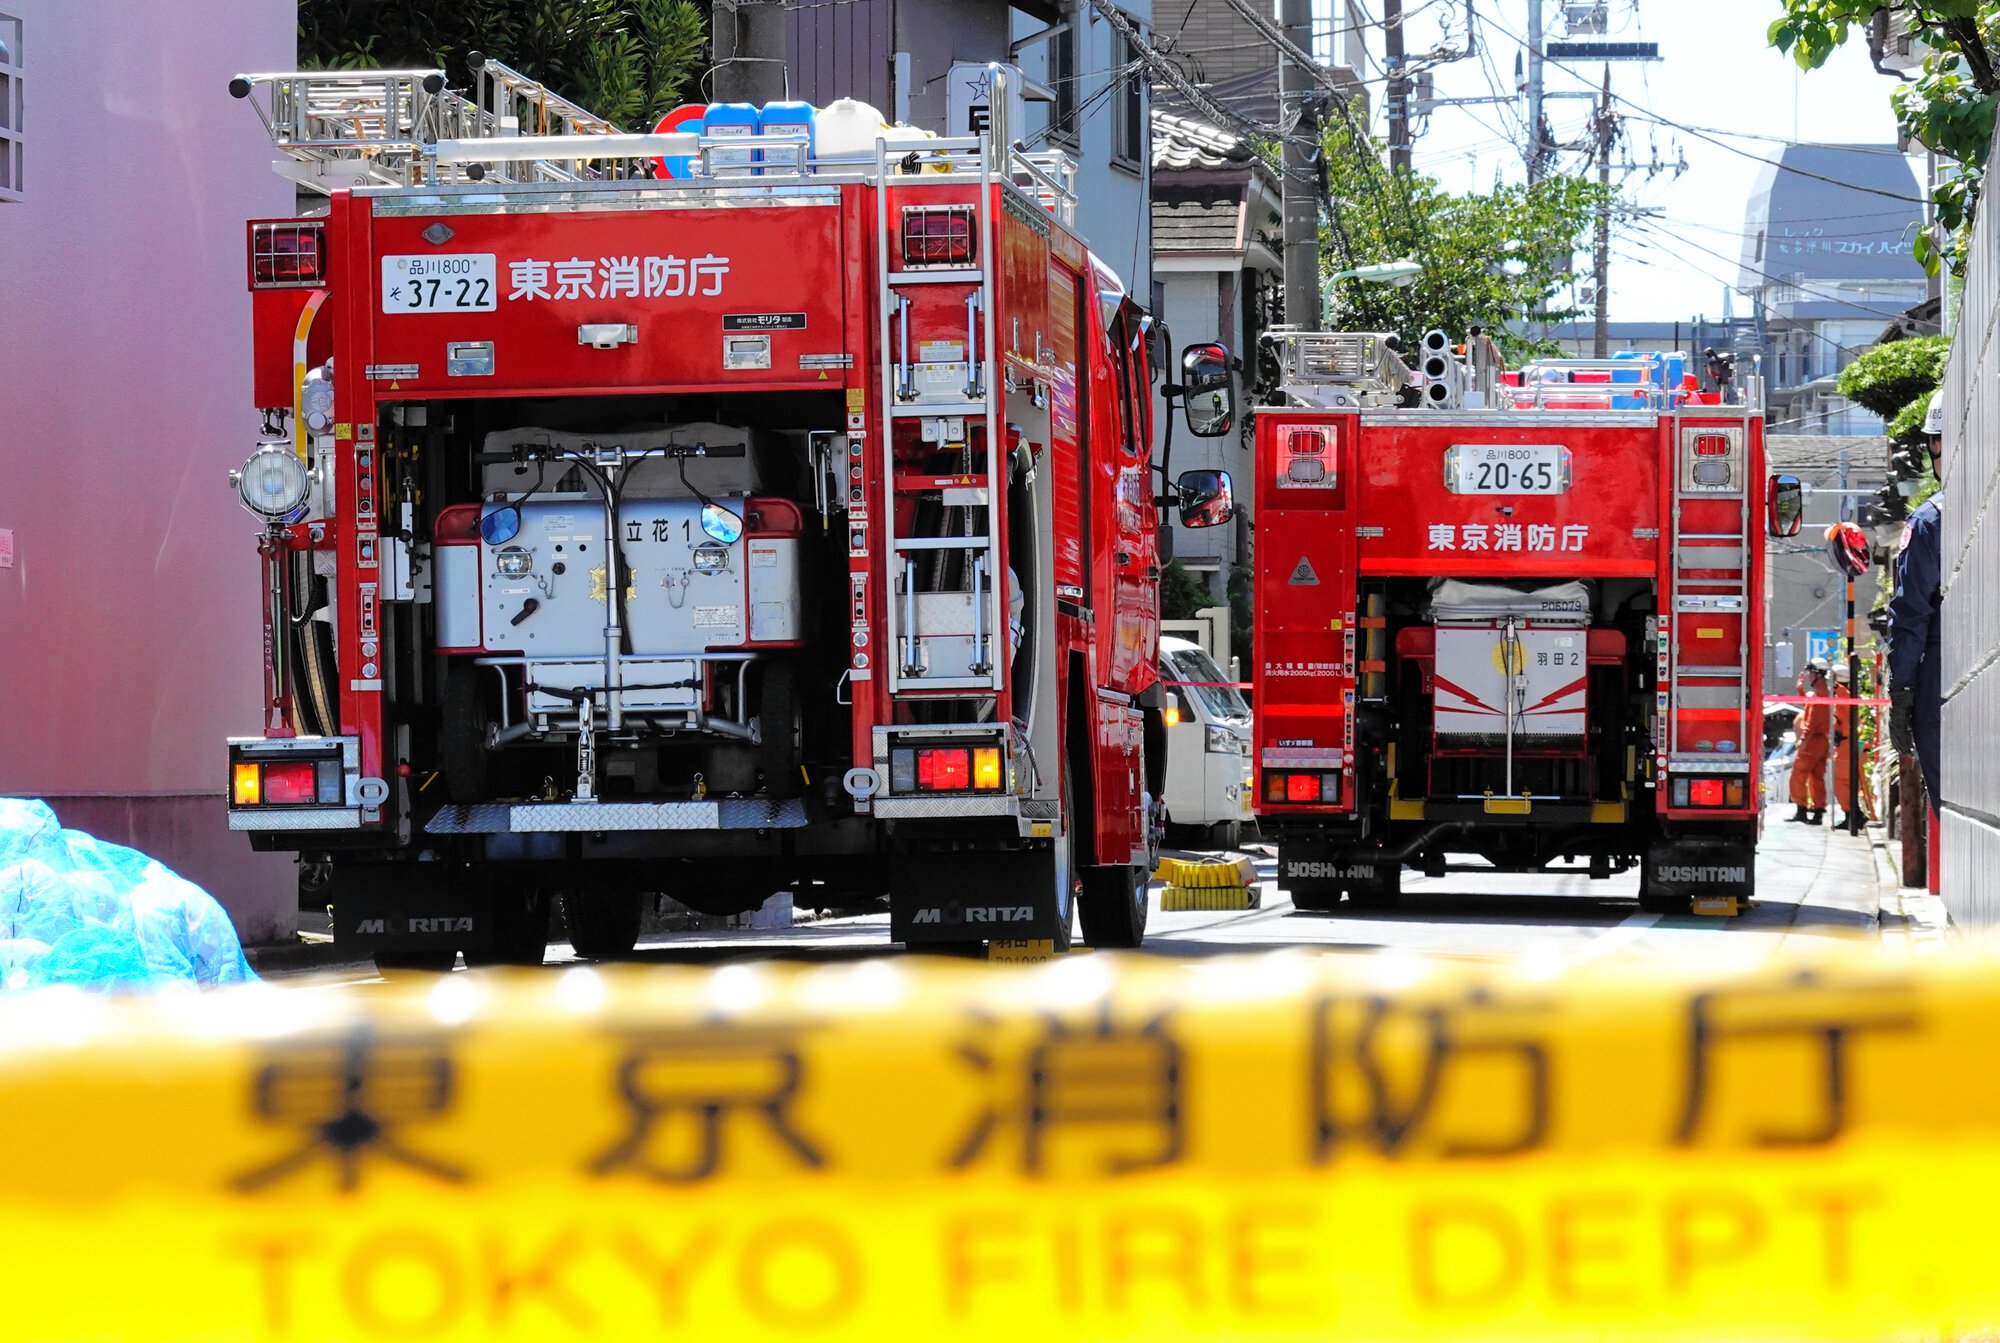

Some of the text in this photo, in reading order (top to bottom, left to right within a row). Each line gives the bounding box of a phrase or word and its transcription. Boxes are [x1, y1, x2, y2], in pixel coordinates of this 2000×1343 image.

[508, 253, 730, 301] 東京消防庁
[390, 278, 490, 307] そ 37-22
[1465, 462, 1551, 490] は 20-65
[1428, 523, 1588, 551] 東京消防庁
[1658, 865, 1745, 882] YOSHITANI
[226, 972, 1925, 1196] 東京消防庁
[221, 1212, 866, 1341] TOKYO
[943, 1200, 1327, 1320] FIRE
